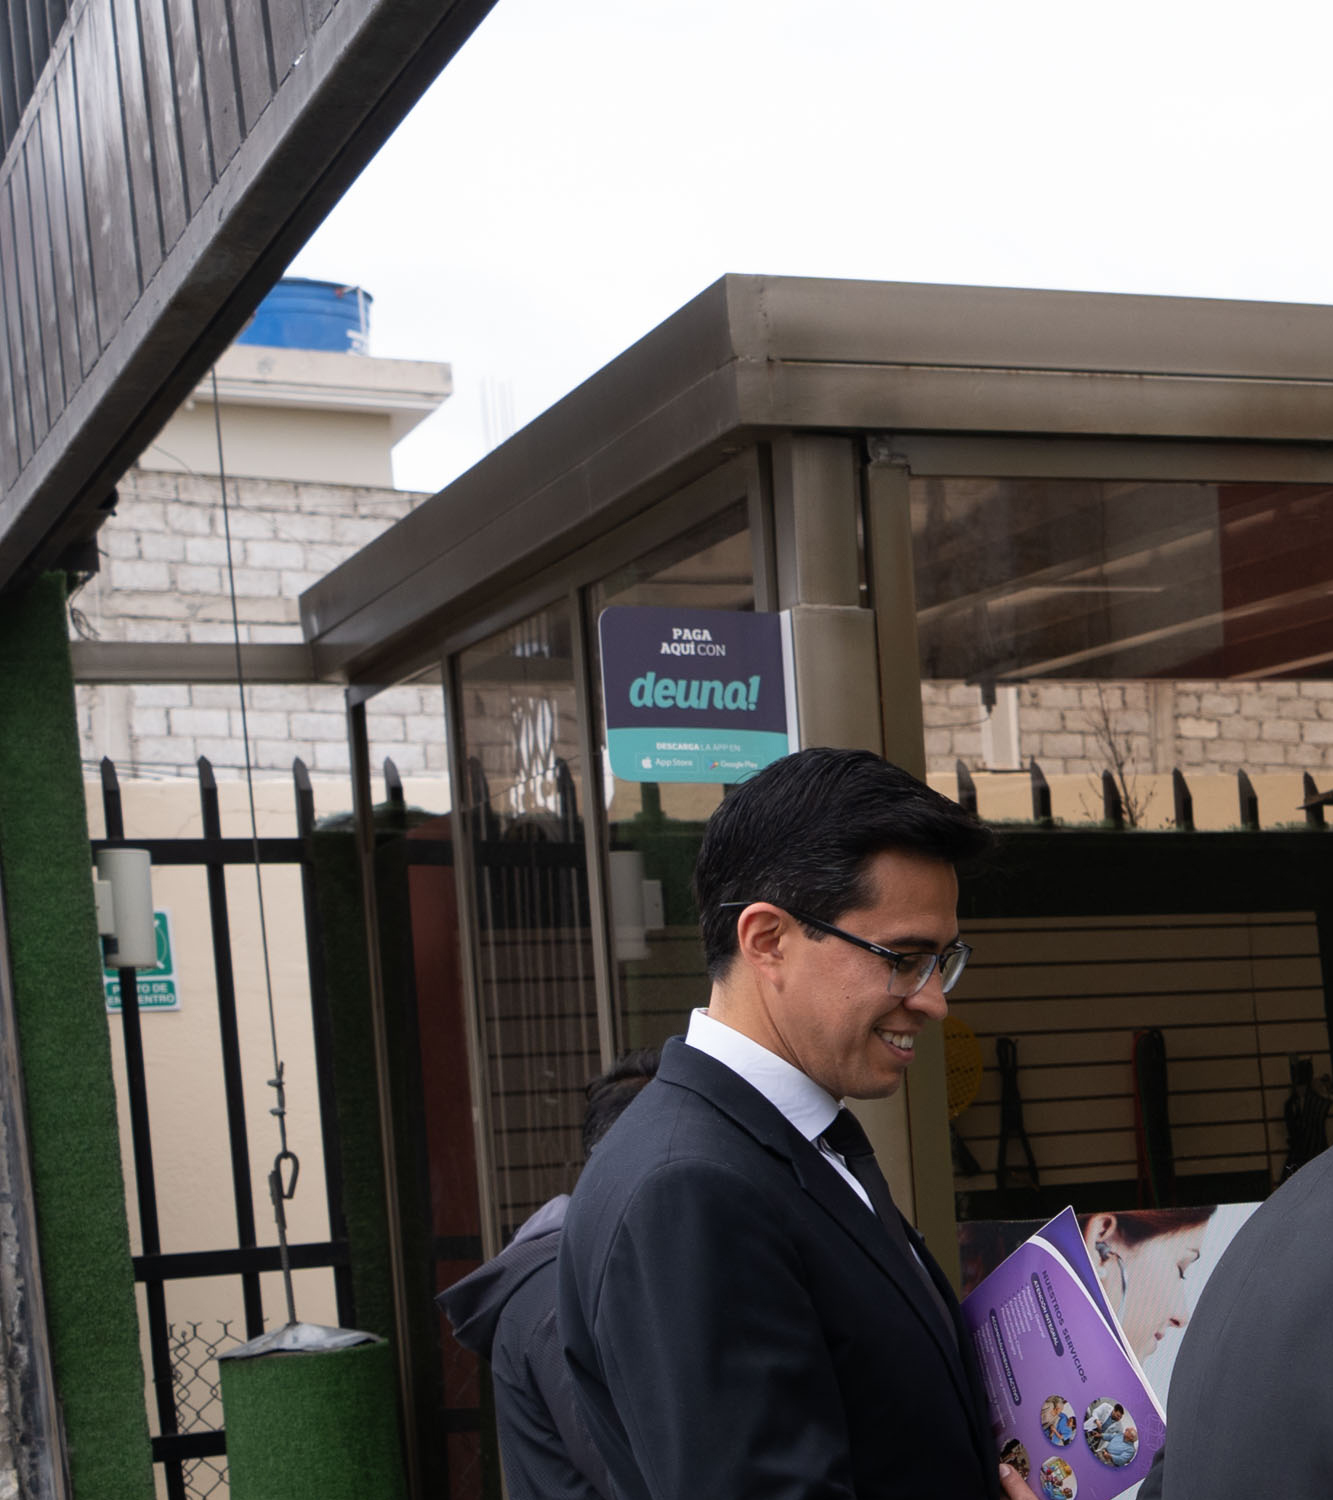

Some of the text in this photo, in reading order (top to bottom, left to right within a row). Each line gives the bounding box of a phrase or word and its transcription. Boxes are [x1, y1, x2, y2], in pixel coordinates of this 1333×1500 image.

[672, 628, 712, 641] PAGA
[660, 640, 726, 656] AQUÍ CON
[629, 672, 761, 711] deuna!
[656, 742, 741, 752] DESCARGA LA APP EN
[655, 758, 671, 768] App
[720, 760, 758, 770] Google Play
[112, 983, 168, 994] PTO DE
[1041, 1269, 1088, 1384] NUESTROS SERVICIOS
